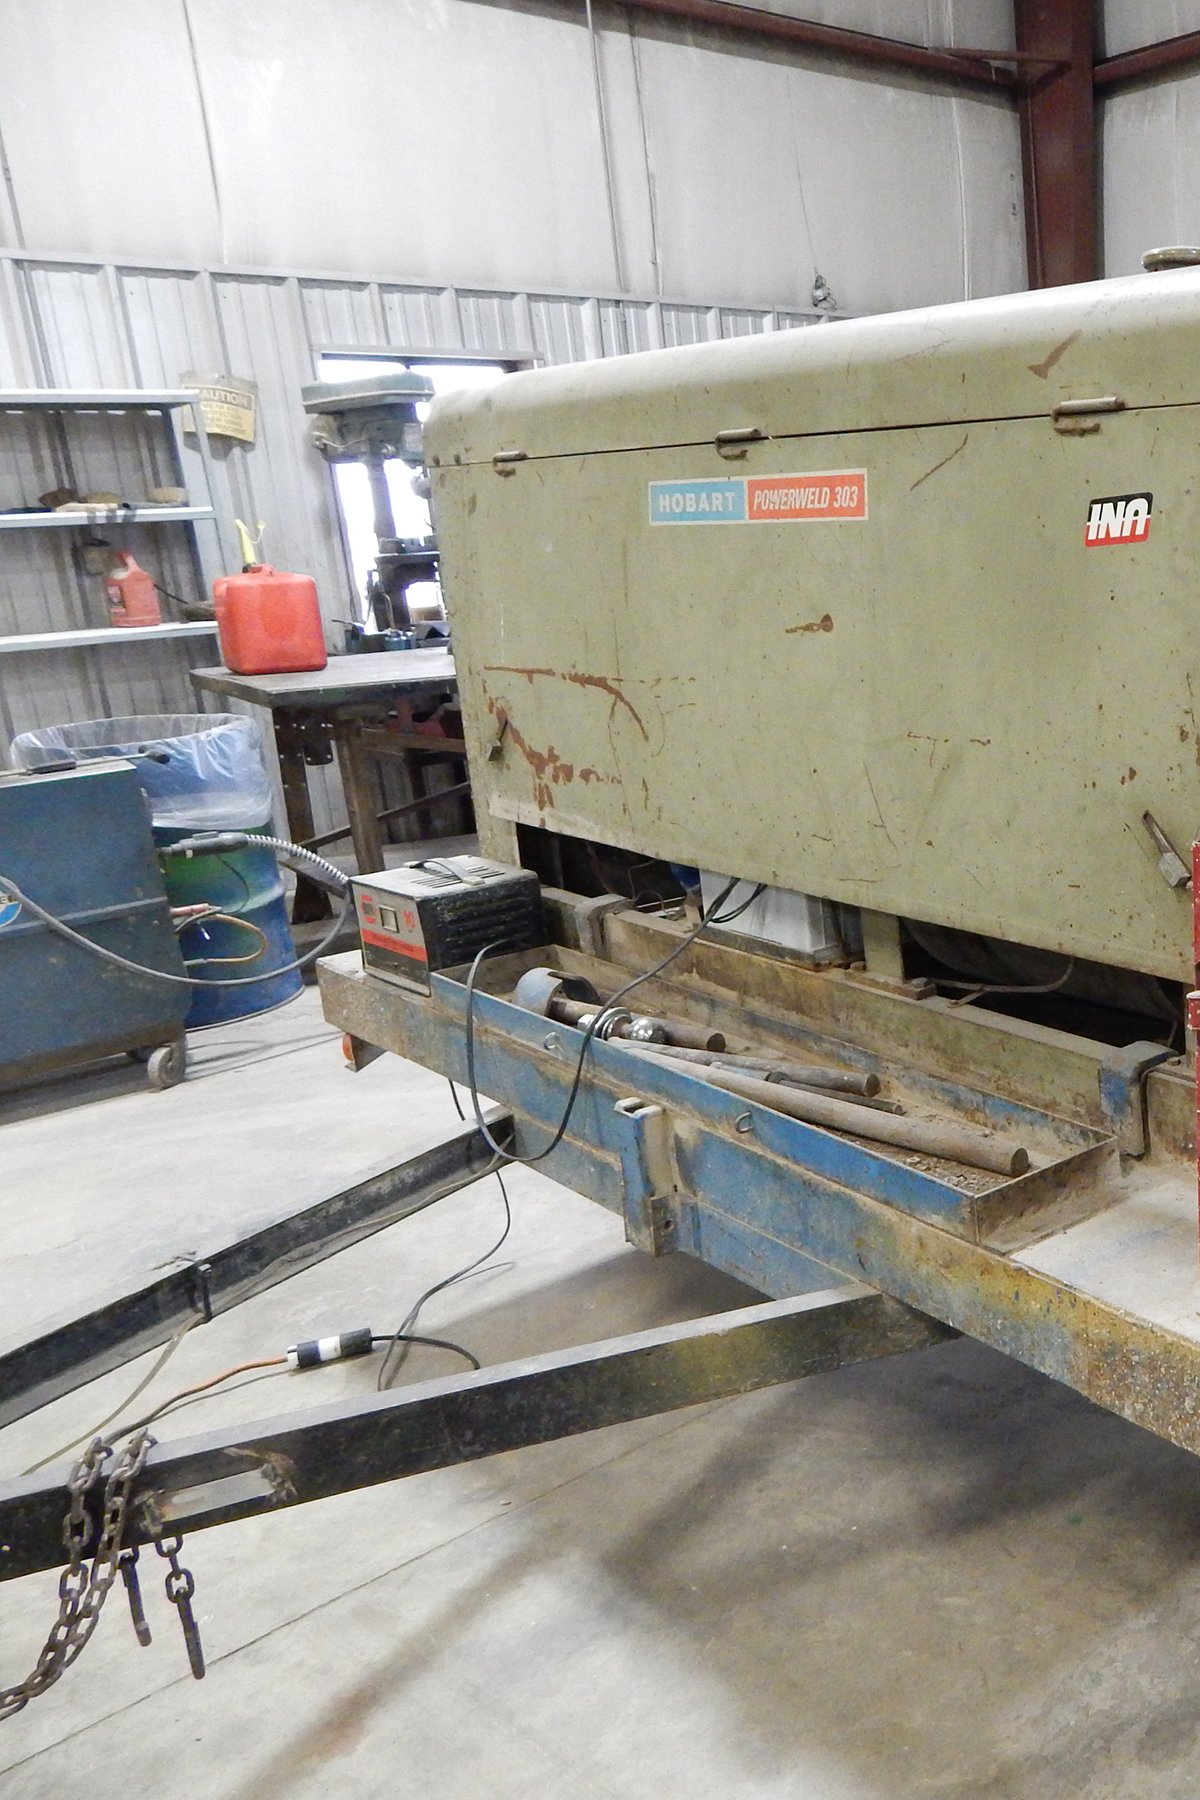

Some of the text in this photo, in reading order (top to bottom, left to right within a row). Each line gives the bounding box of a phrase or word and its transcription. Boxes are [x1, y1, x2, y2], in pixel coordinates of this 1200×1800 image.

[200, 388, 249, 407] AUTION
[657, 484, 859, 514] HOBART POWERWELD 303
[1086, 498, 1152, 540] INA
